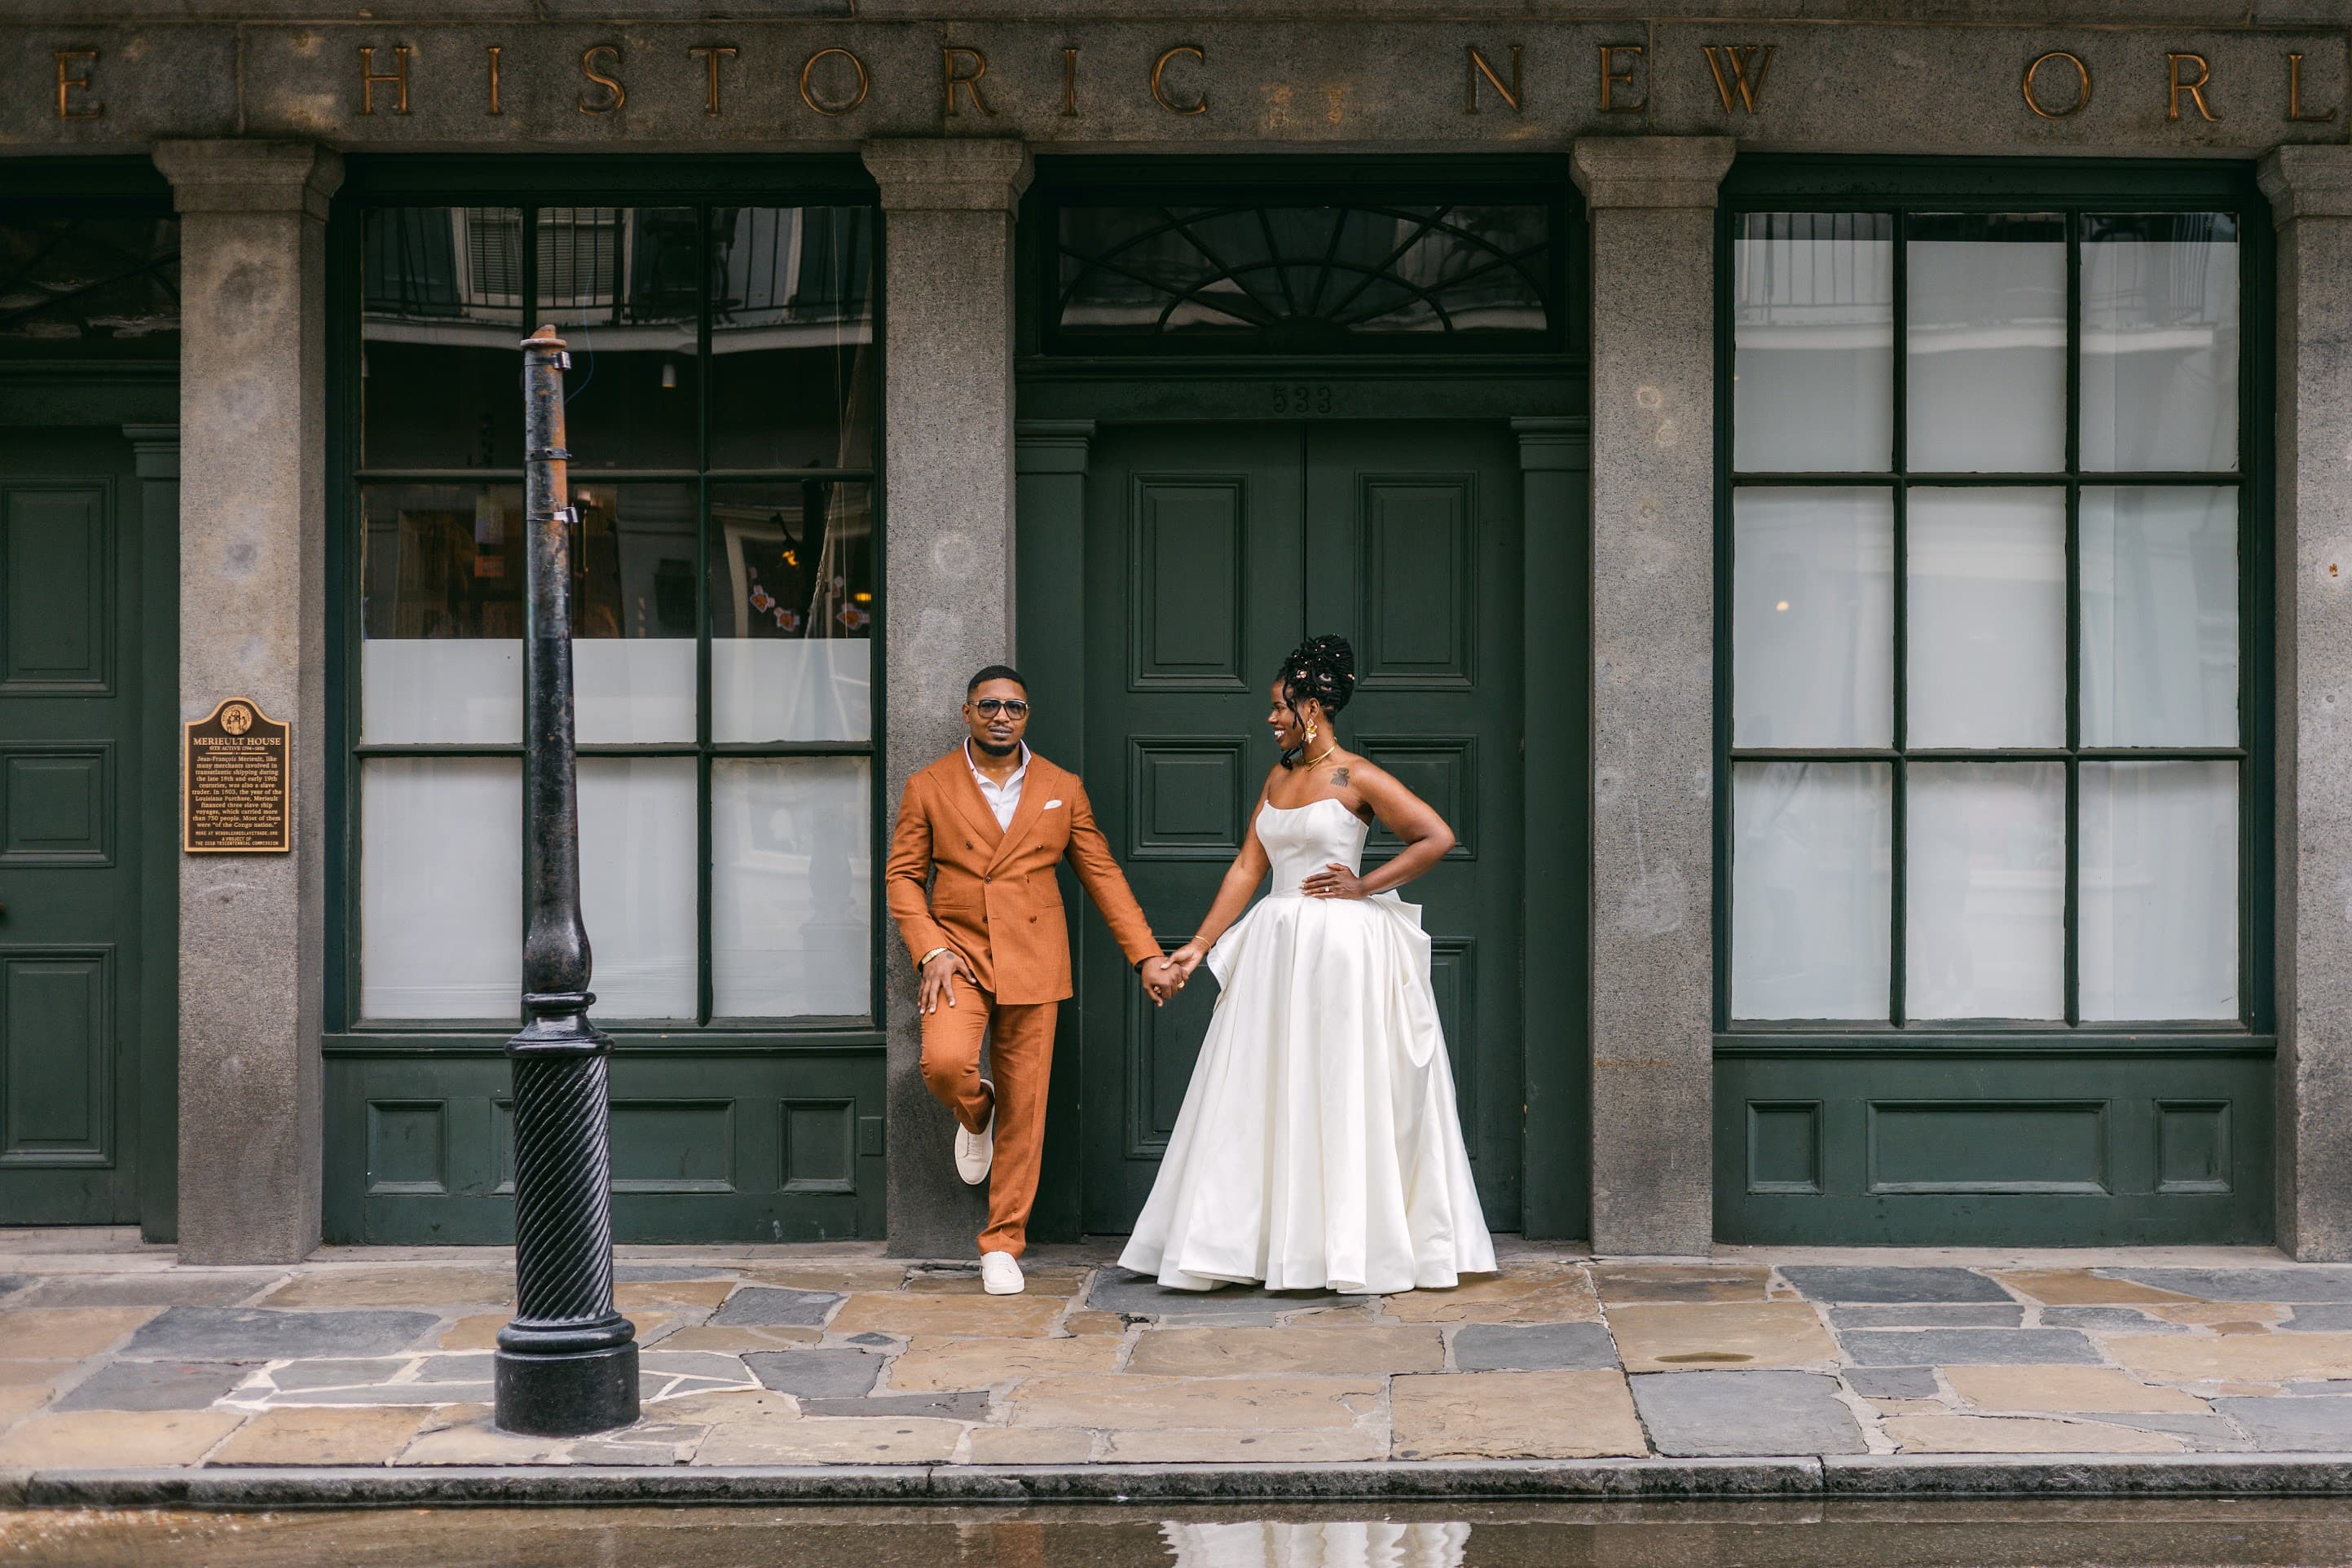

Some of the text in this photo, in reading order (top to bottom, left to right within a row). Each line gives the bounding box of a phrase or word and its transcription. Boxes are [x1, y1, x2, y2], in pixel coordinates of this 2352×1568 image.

[359, 45, 1208, 117] HISTORIC
[1467, 46, 1778, 115] NEW
[2023, 52, 2336, 122] ORL
[1273, 384, 1332, 413] 533
